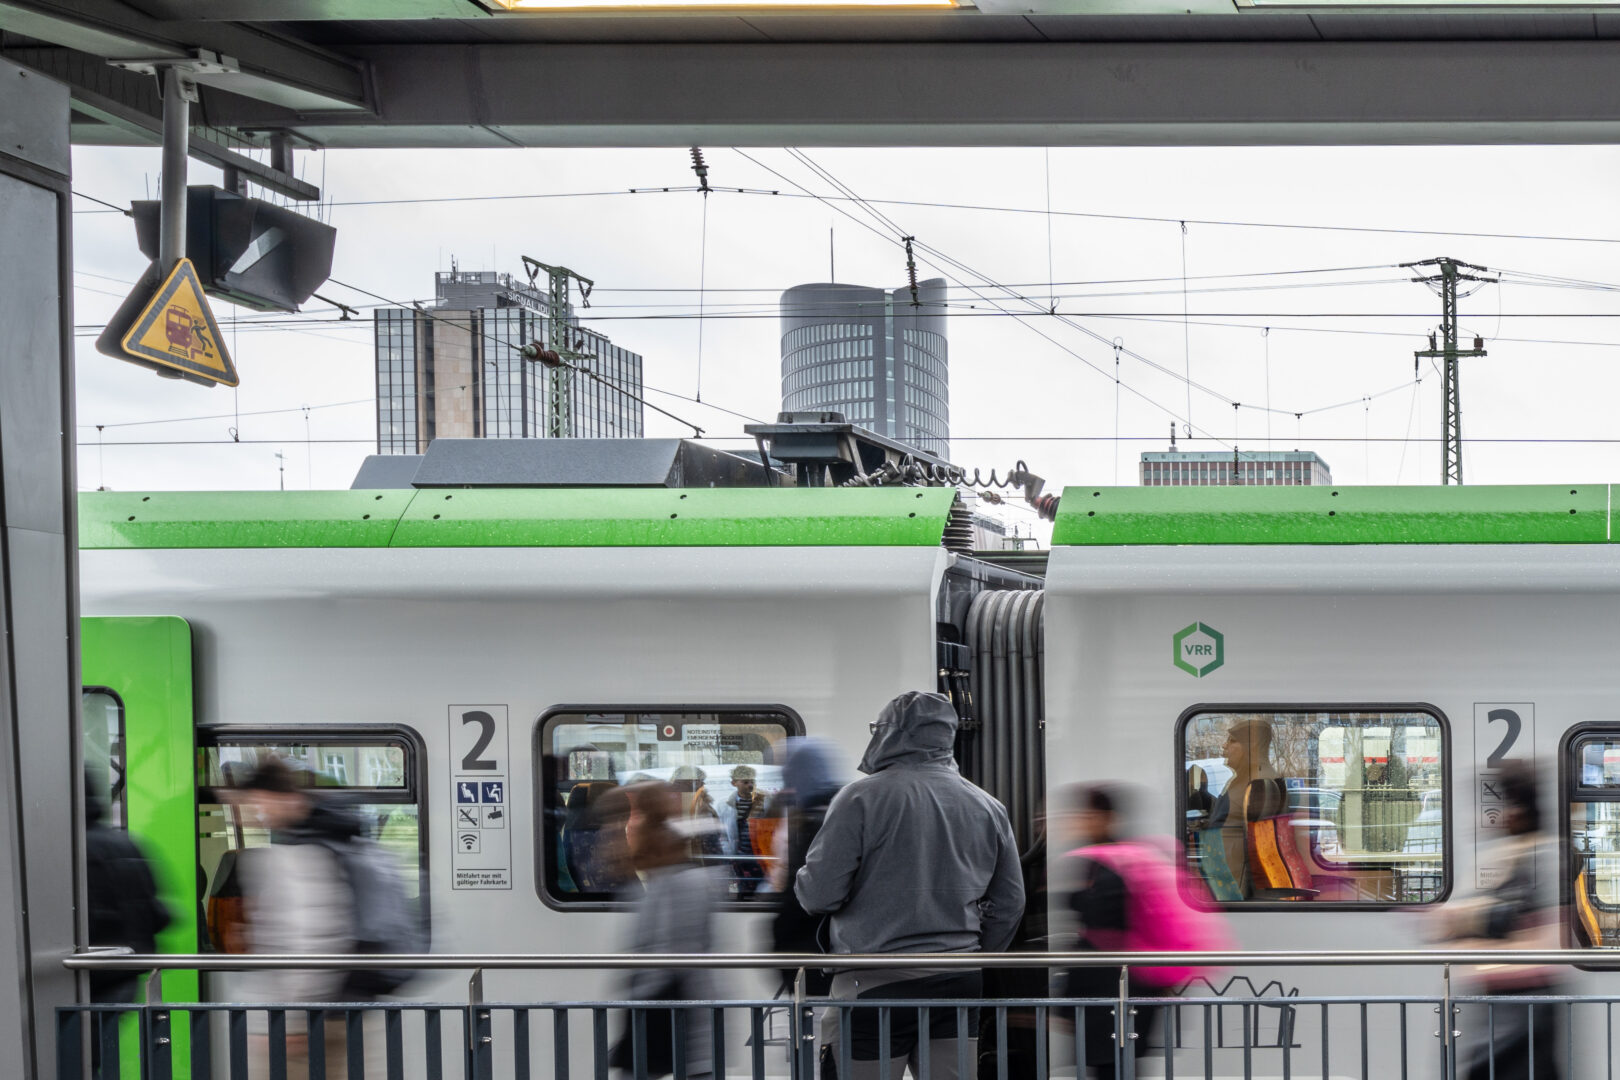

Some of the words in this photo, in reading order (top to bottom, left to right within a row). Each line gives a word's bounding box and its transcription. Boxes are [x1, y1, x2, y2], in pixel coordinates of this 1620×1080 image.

[508, 292, 536, 309] SIGNAL
[1184, 644, 1212, 656] VRR
[462, 710, 497, 771] 2
[1486, 708, 1523, 769] 2
